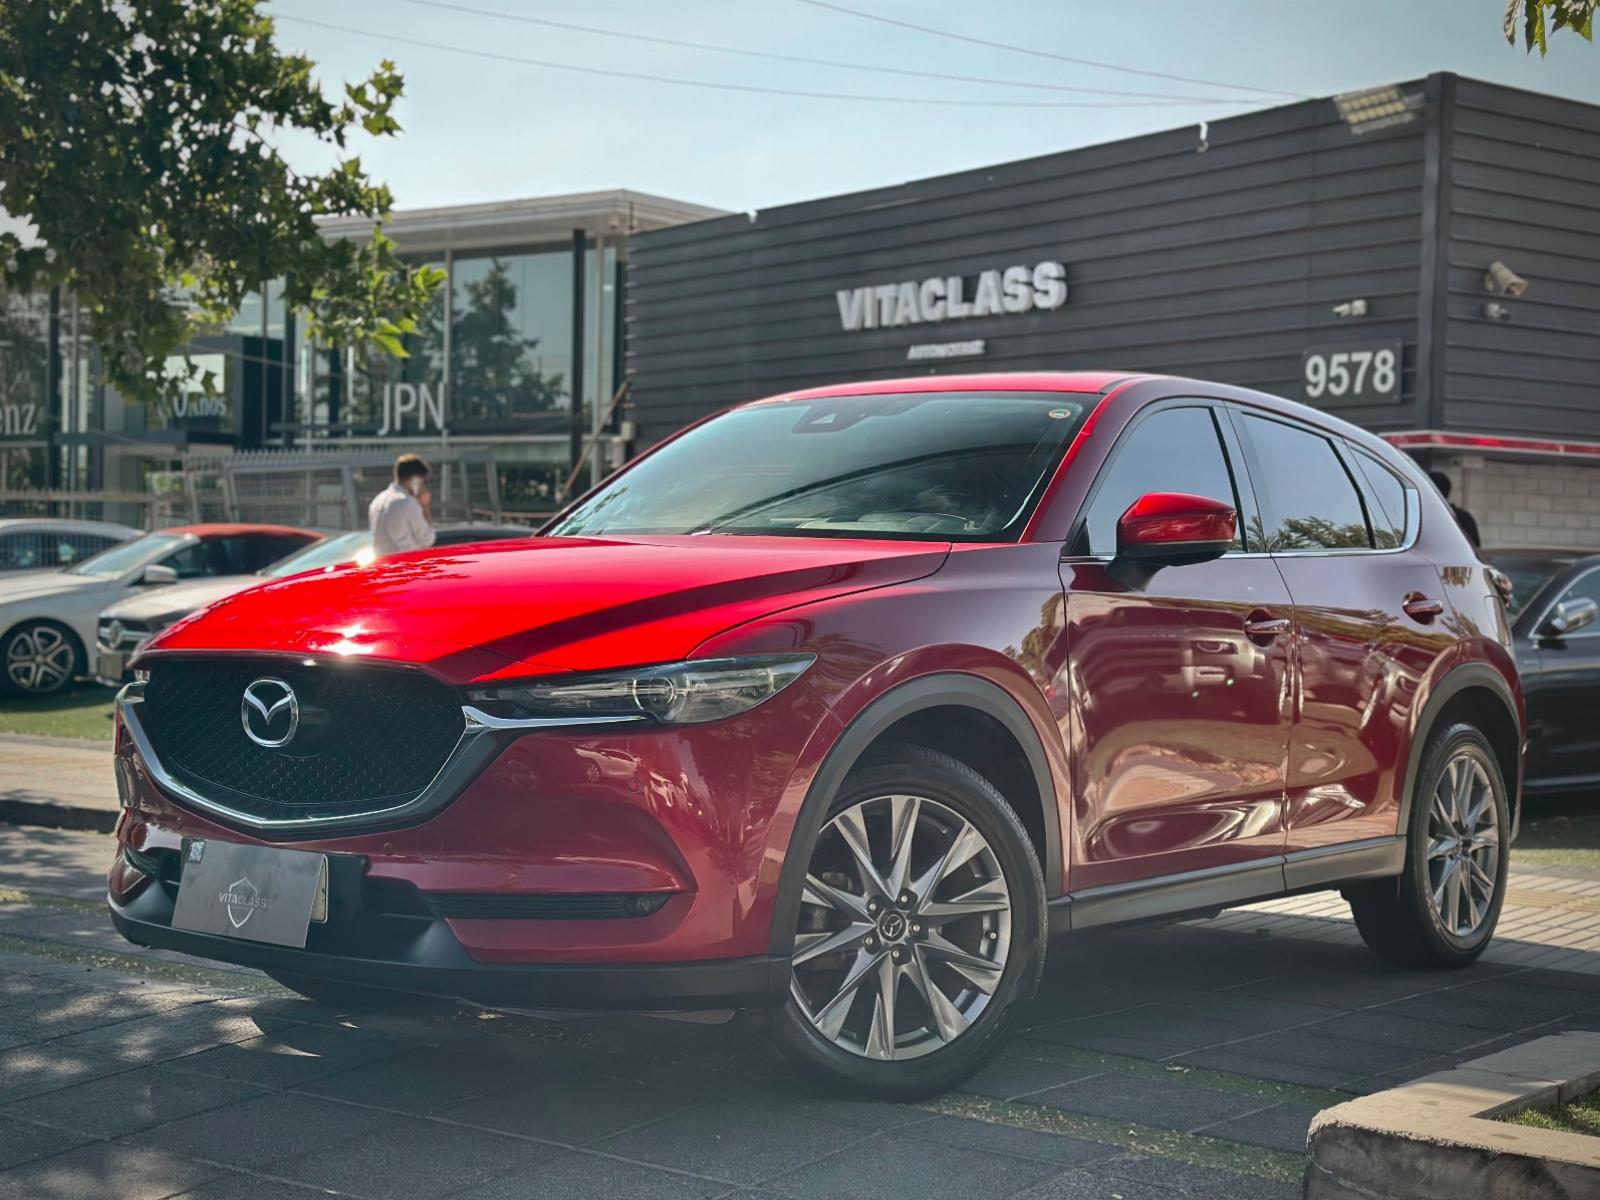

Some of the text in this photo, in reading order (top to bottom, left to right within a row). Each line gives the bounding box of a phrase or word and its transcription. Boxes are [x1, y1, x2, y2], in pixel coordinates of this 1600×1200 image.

[836, 261, 1068, 331] VITACLASS
[1305, 349, 1396, 397] 9578
[0, 403, 37, 435] nz
[377, 382, 445, 436] JPN
